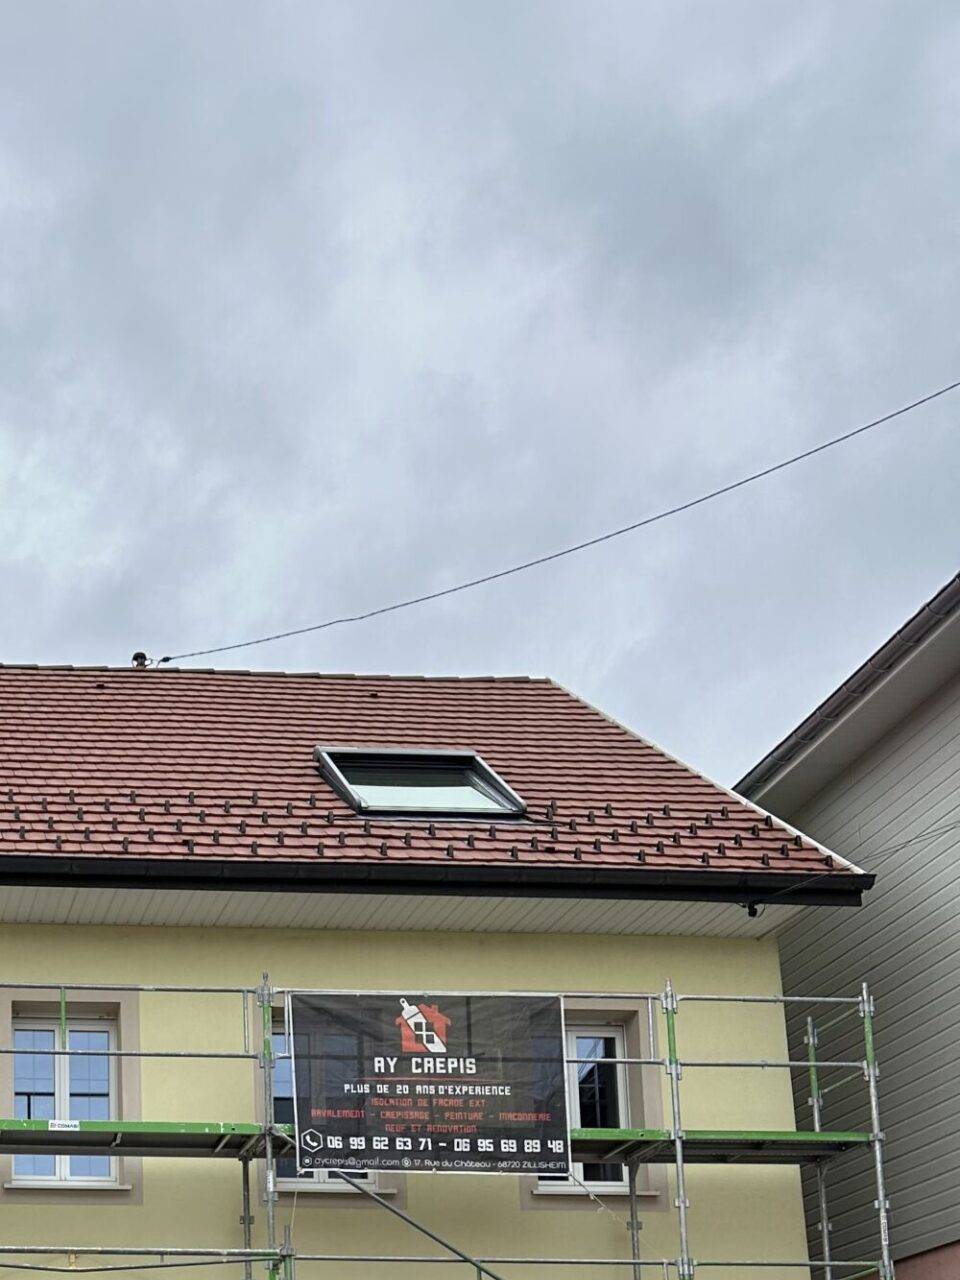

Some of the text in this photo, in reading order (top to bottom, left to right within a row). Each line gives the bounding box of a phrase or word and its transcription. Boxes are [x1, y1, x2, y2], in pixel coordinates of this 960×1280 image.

[374, 1057, 477, 1074] AY CREPIS
[344, 1084, 511, 1096] PLUS DE 20 ANS D'EXPERIENCE
[371, 1098, 413, 1107] ISOLATION
[417, 1099, 429, 1107] DE
[311, 1109, 365, 1119] RAVALEMENT
[380, 1111, 430, 1120] CREPISSAGE
[444, 1112, 484, 1121] PEINTURE
[385, 1123, 478, 1134] NEUF ET RENOVATION
[327, 1136, 343, 1149] 06
[349, 1136, 366, 1150] 99
[372, 1136, 389, 1150] 62
[395, 1137, 412, 1151] 63
[418, 1138, 432, 1151] 71
[454, 1138, 470, 1152] 06
[477, 1139, 494, 1152] 95
[500, 1139, 517, 1153] 69
[524, 1139, 541, 1153] 89
[547, 1140, 564, 1153] 48
[314, 1157, 400, 1168] aycrepis@gmail.com
[441, 1160, 452, 1168] du
[453, 1160, 491, 1169] Château
[497, 1161, 520, 1169] 68720
[522, 1161, 567, 1170] ZILLISHEIM
